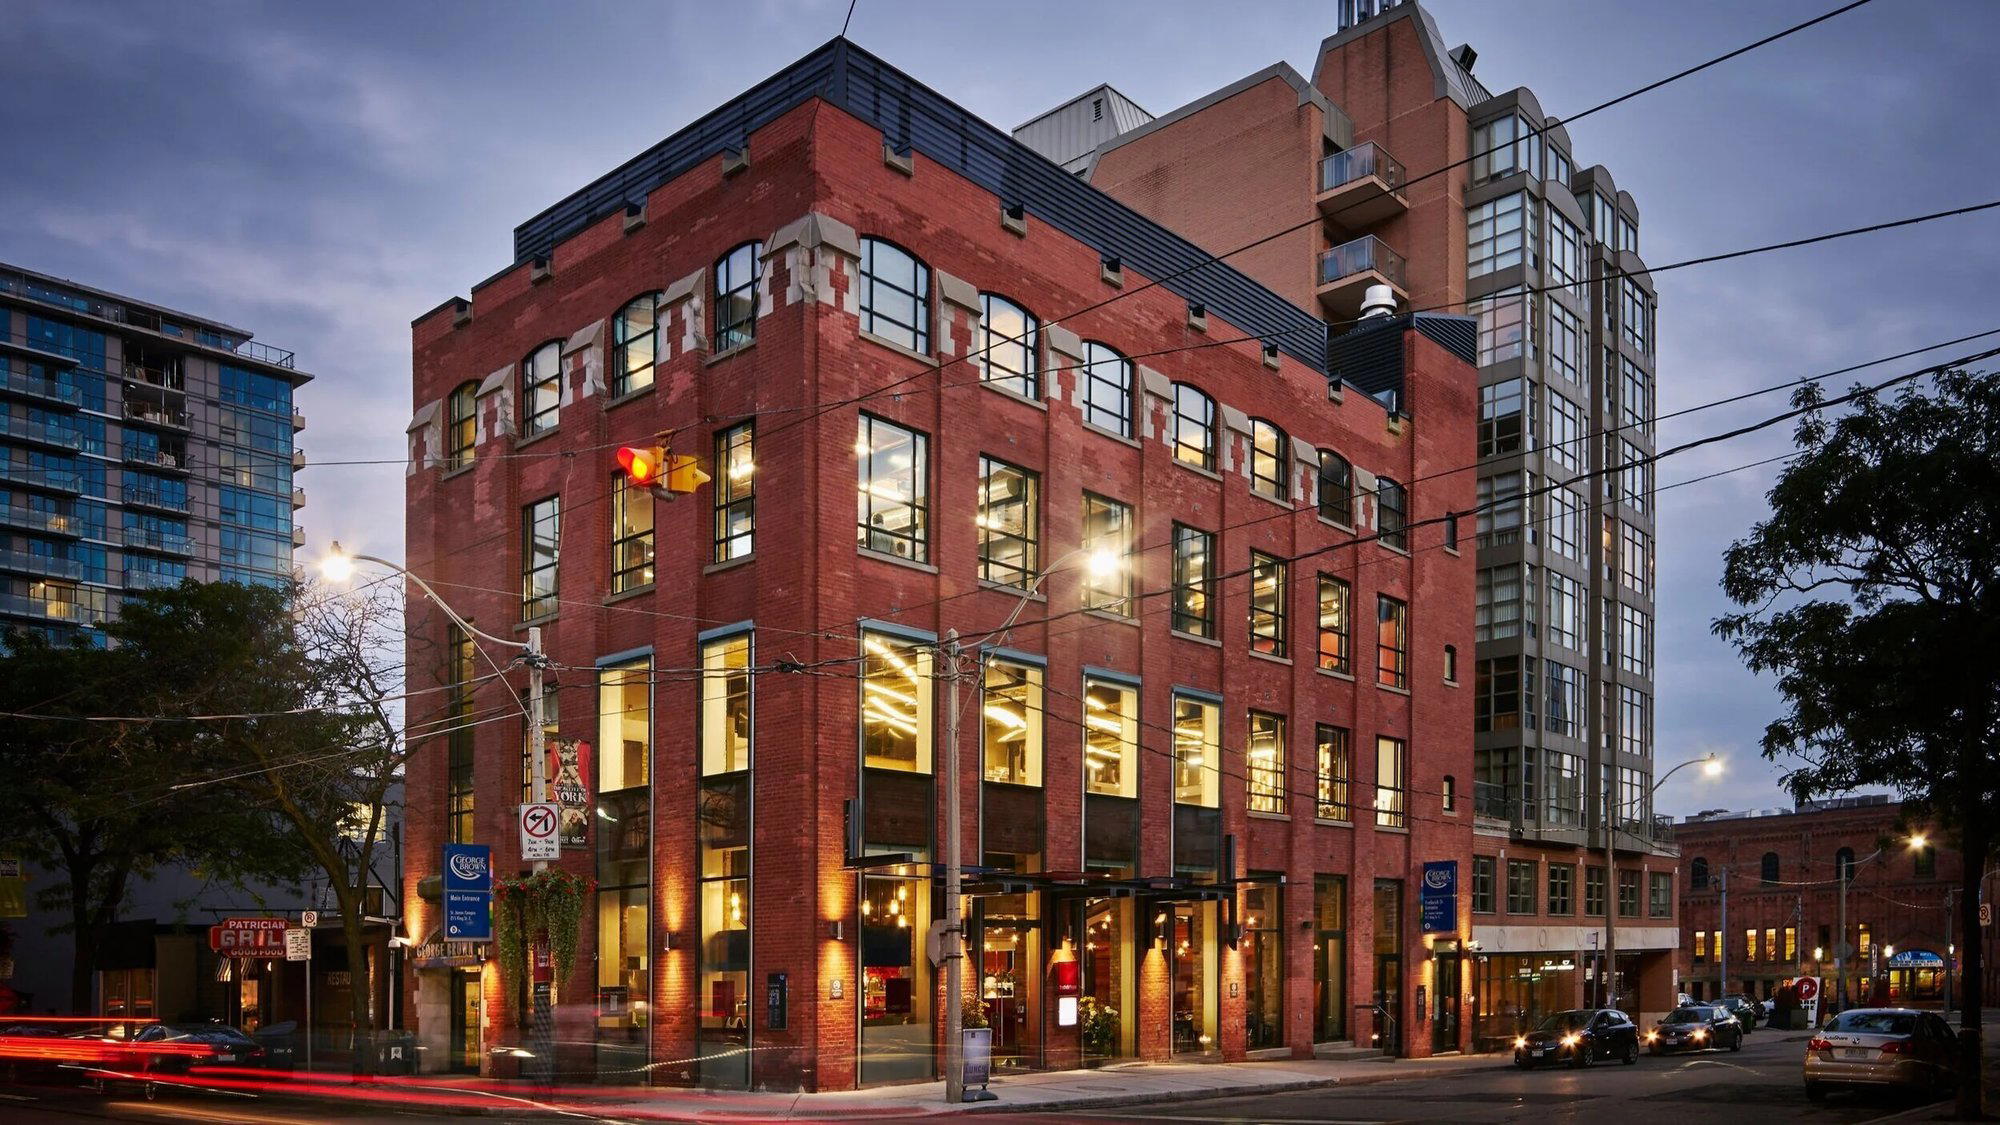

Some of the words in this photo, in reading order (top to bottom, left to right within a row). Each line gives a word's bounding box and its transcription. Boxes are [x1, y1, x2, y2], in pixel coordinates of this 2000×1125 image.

[554, 791, 587, 802] YORK
[455, 856, 486, 864] GEORGE
[461, 894, 480, 902] Entrance
[229, 920, 286, 930] PATRICIAN
[231, 948, 258, 956] GOOD
[259, 948, 284, 956] FOOD
[416, 943, 445, 958] GEORGE
[446, 941, 474, 957] BROWN
